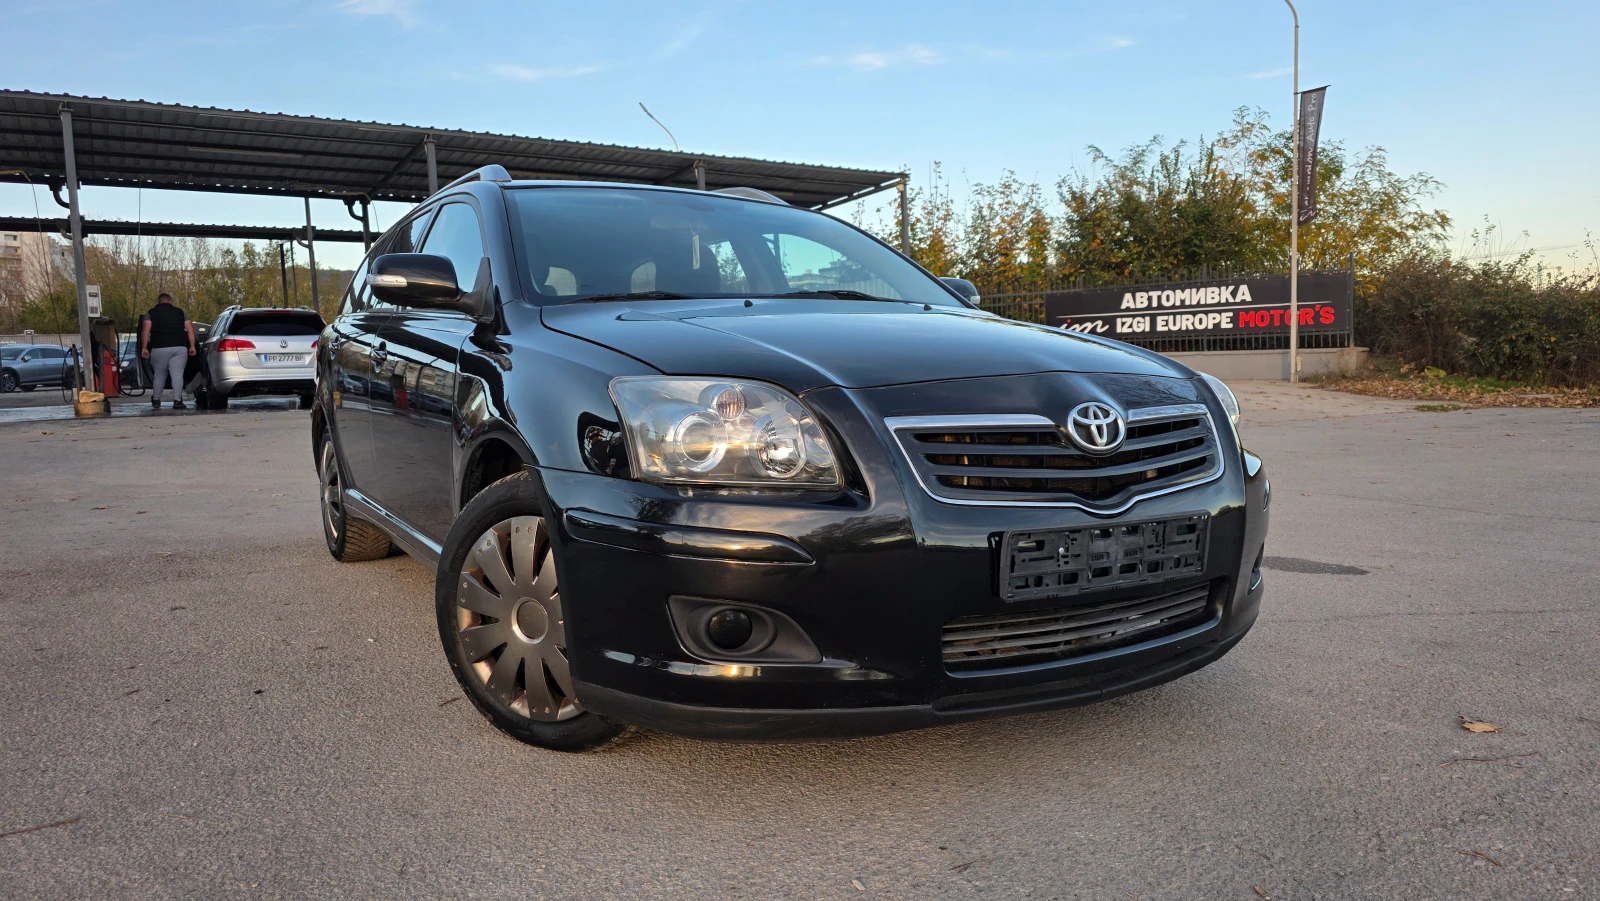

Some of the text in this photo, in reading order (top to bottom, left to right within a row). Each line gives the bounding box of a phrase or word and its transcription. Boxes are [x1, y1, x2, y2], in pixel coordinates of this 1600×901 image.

[1120, 284, 1252, 310] АВТОМИВКА
[1116, 316, 1151, 333] IZGI
[1157, 312, 1234, 332] EUROPE
